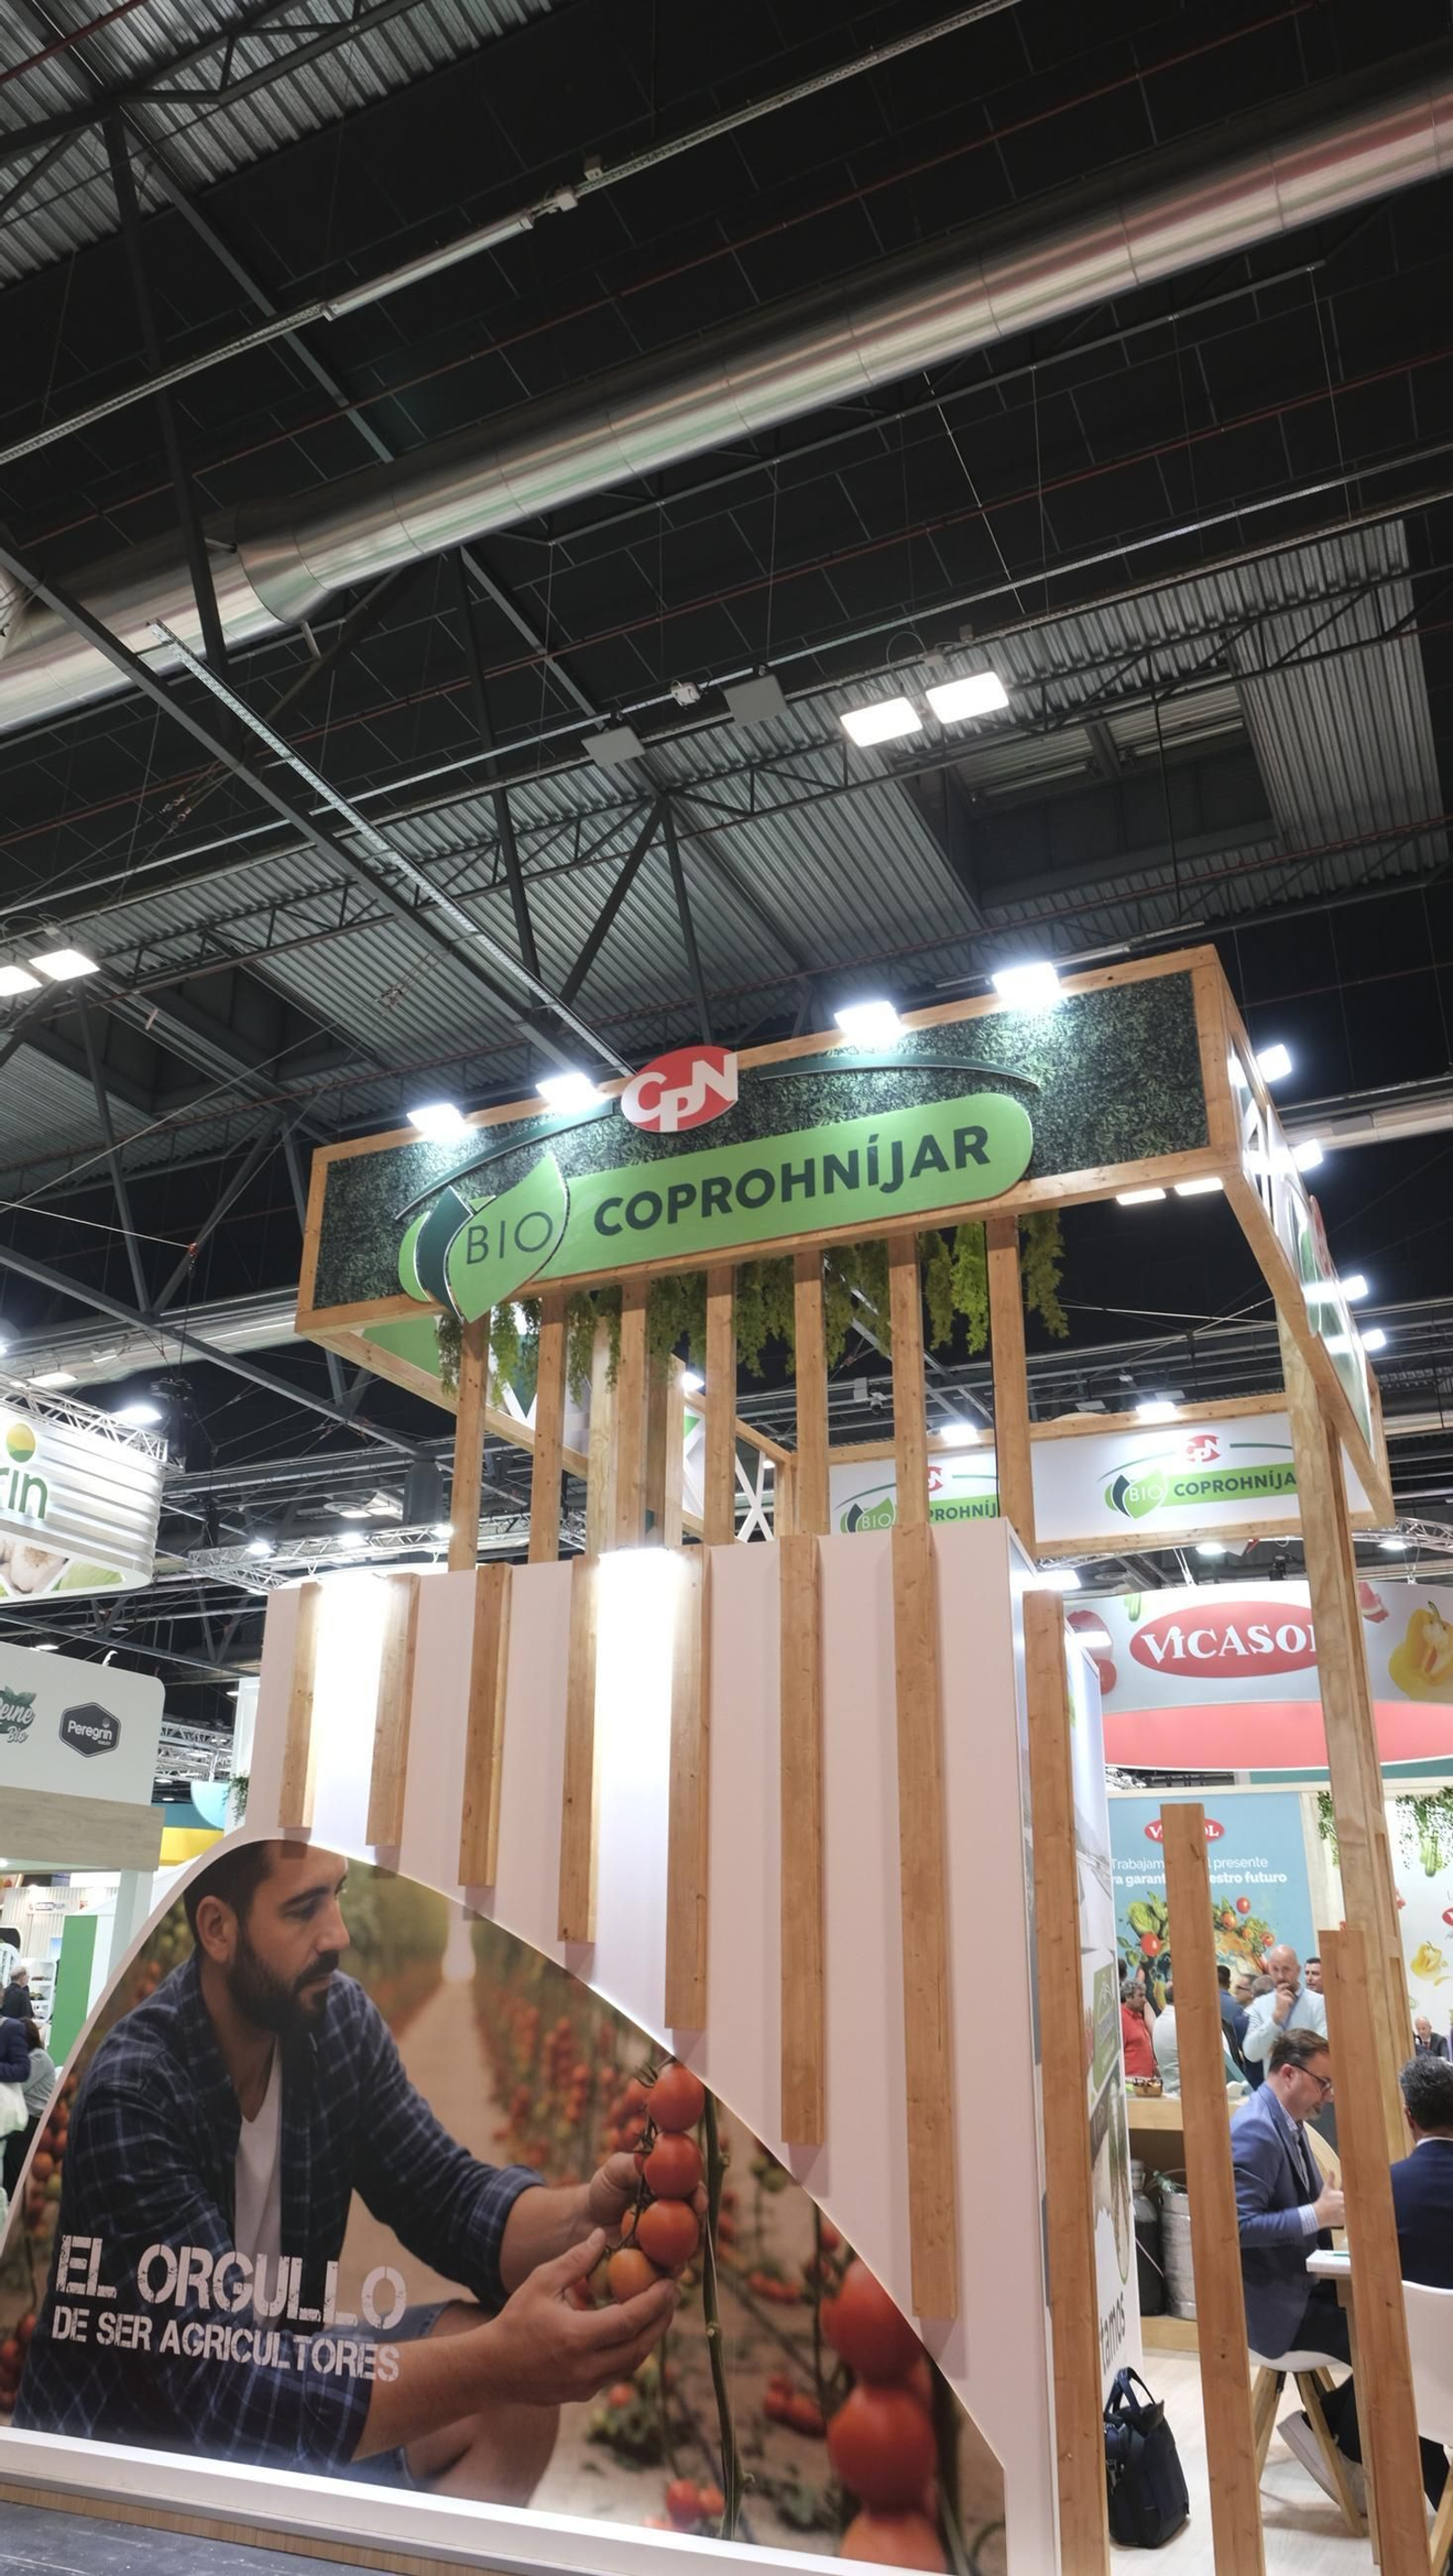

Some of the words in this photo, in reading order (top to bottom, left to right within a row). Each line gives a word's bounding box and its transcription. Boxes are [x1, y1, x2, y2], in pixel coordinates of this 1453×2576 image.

[621, 1051, 738, 1133] CPN
[466, 1210, 554, 1264] BIO
[593, 1125, 991, 1237] COPROHNÍJAR
[1129, 1483, 1161, 1502] BIO
[862, 1512, 892, 1530] BIO
[67, 1719, 113, 1740] Peregrin
[1213, 1856, 1269, 1871] presente
[1244, 1871, 1289, 1884] futuro
[55, 2234, 117, 2299] EL
[137, 2244, 407, 2331] ORGULLO
[52, 2305, 90, 2343] DE
[95, 2312, 152, 2351] SER
[159, 2319, 400, 2383] AGRICULTORES
